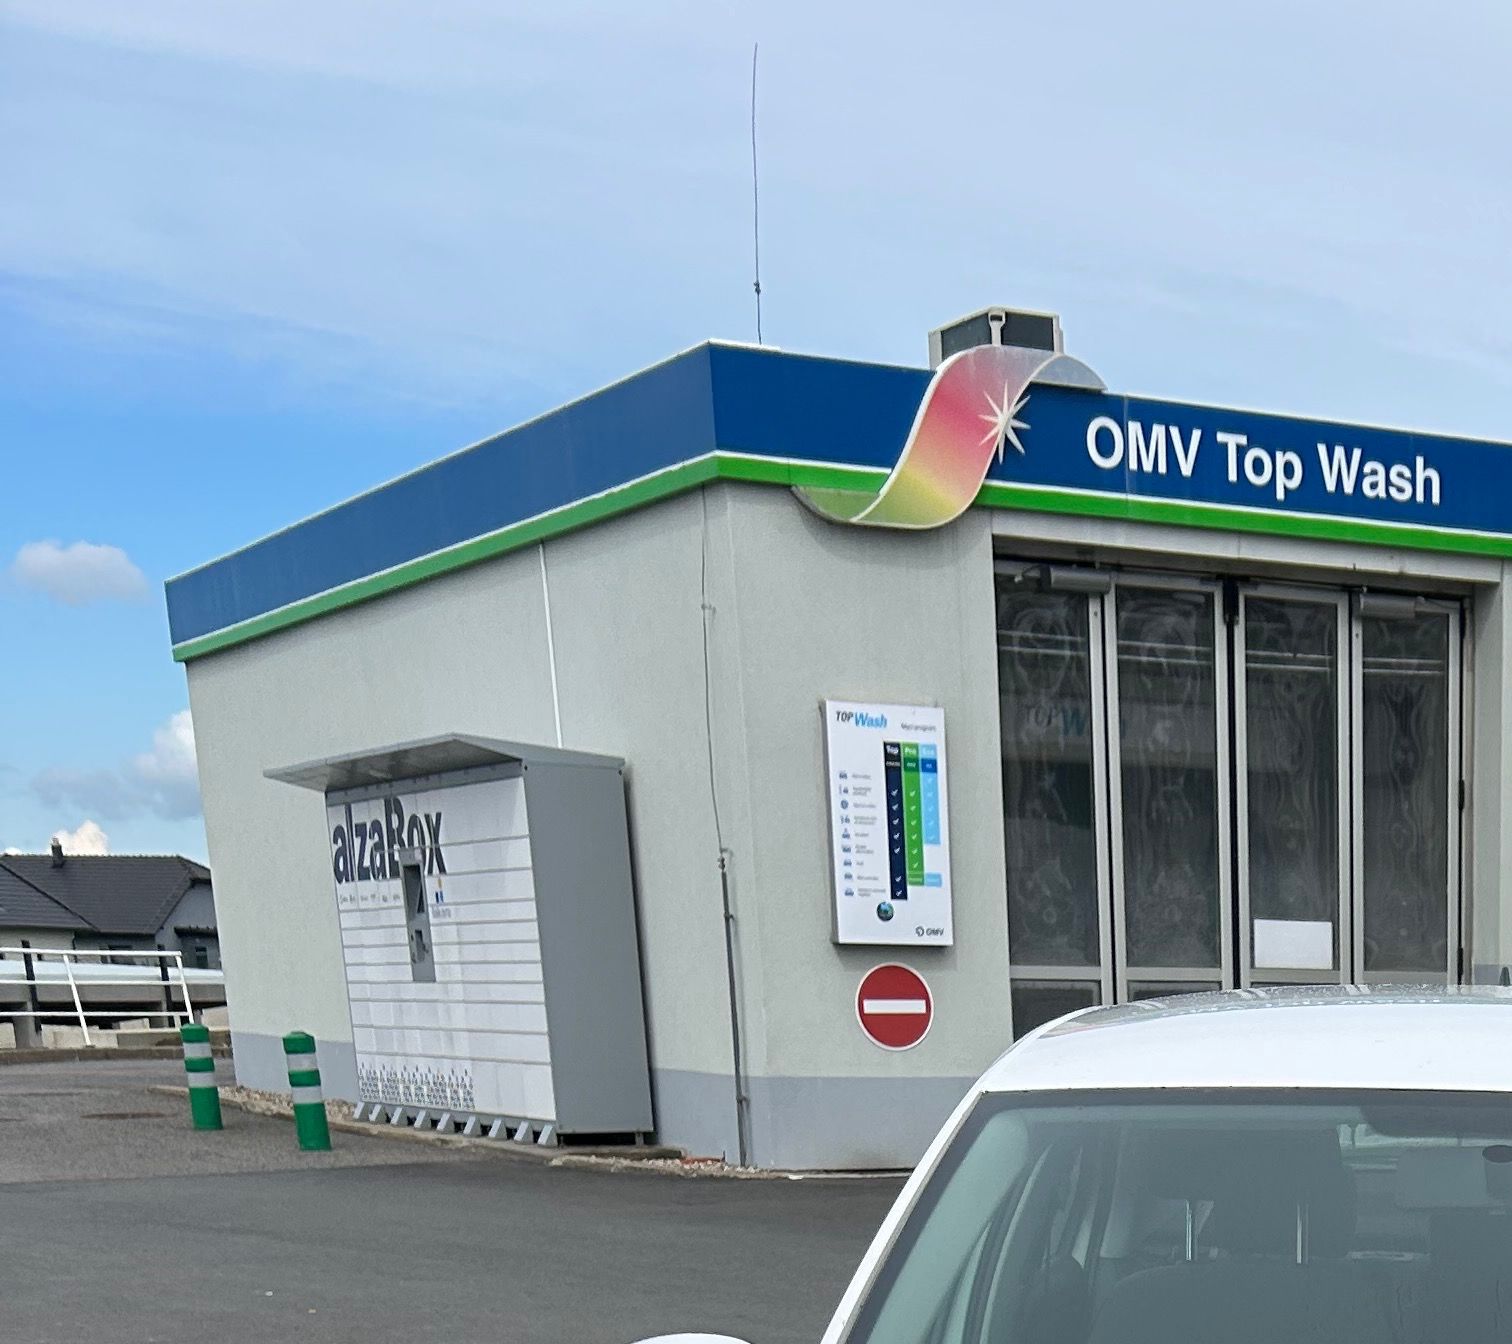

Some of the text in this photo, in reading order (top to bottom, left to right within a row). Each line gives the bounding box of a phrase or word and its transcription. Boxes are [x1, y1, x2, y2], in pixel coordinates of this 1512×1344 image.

[1086, 416, 1441, 506] OMV Top Wash
[836, 710, 888, 729] TOP Wash
[333, 796, 447, 884] alzaBox
